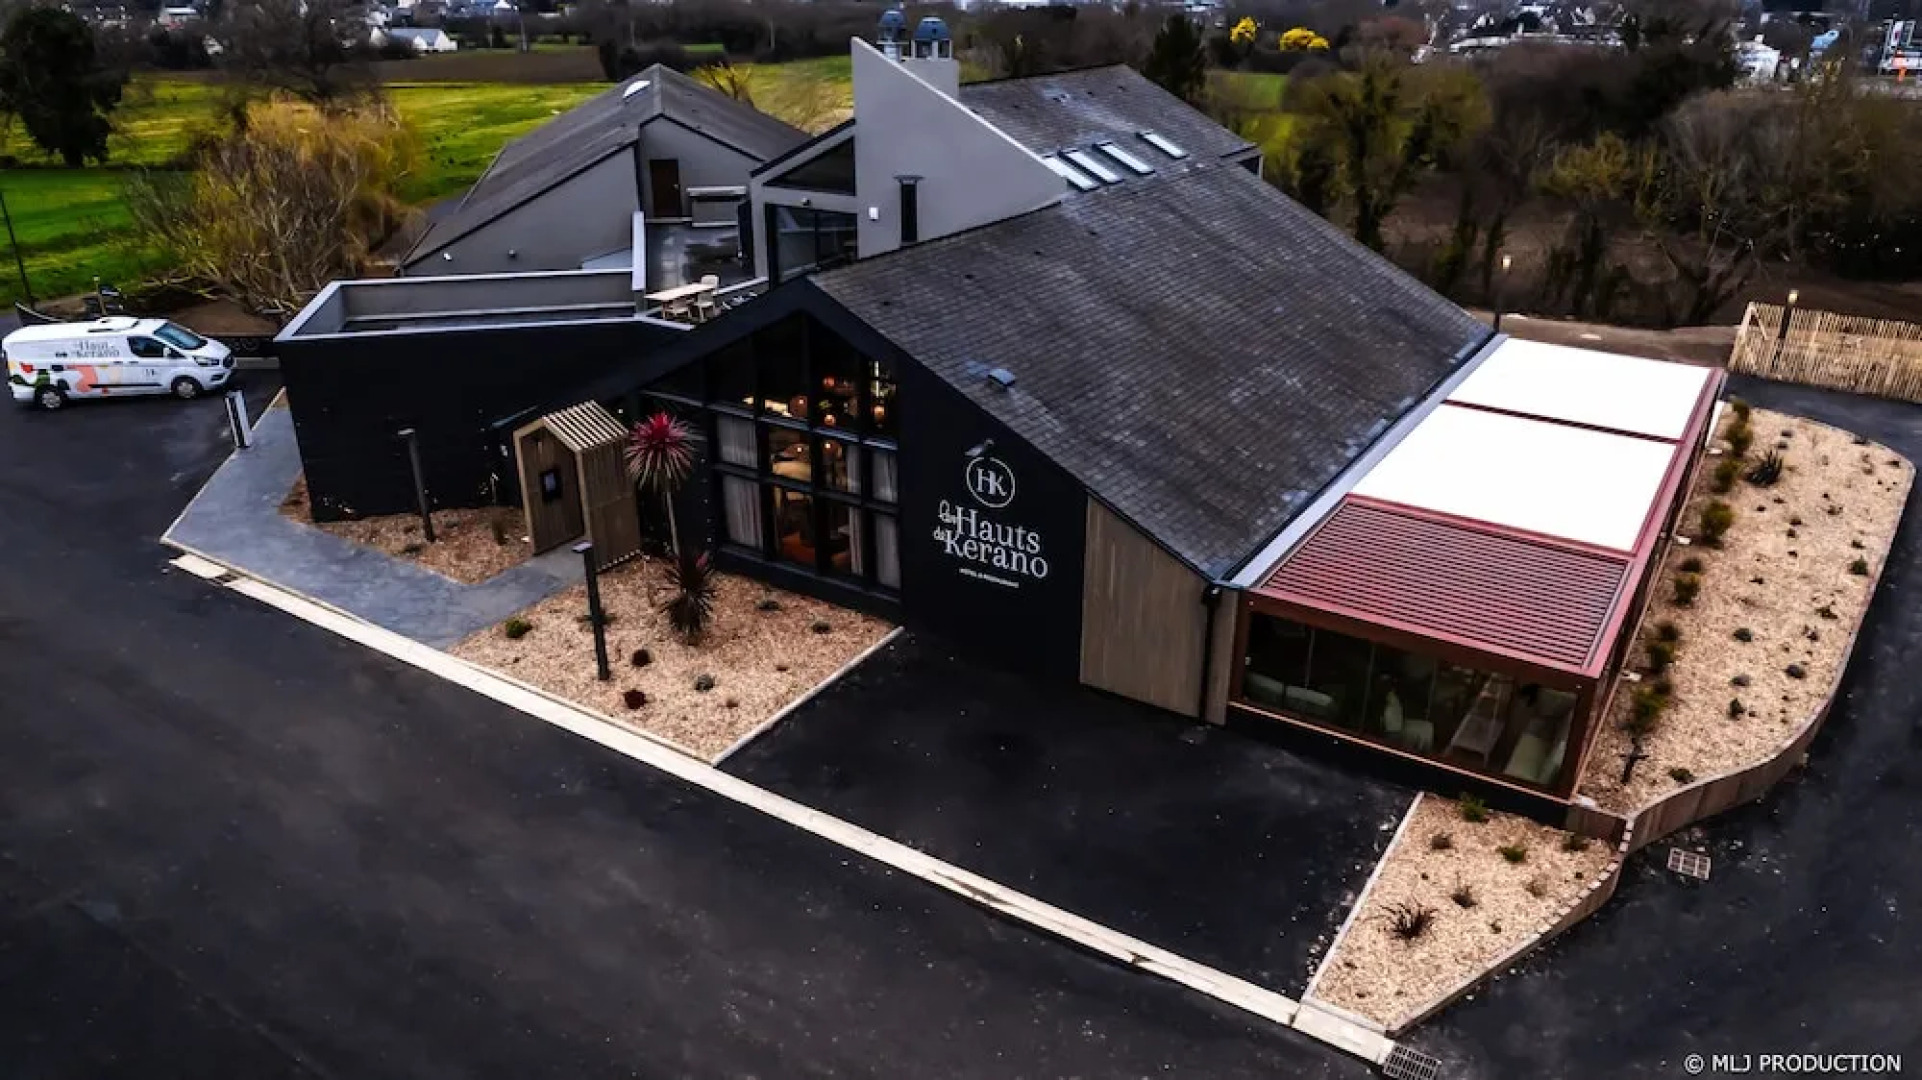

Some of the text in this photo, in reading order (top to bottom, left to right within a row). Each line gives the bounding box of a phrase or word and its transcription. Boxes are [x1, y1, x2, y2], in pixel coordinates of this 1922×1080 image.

[976, 467, 1007, 496] HK
[944, 529, 1049, 579] Kerano
[955, 505, 1041, 554] Hauts
